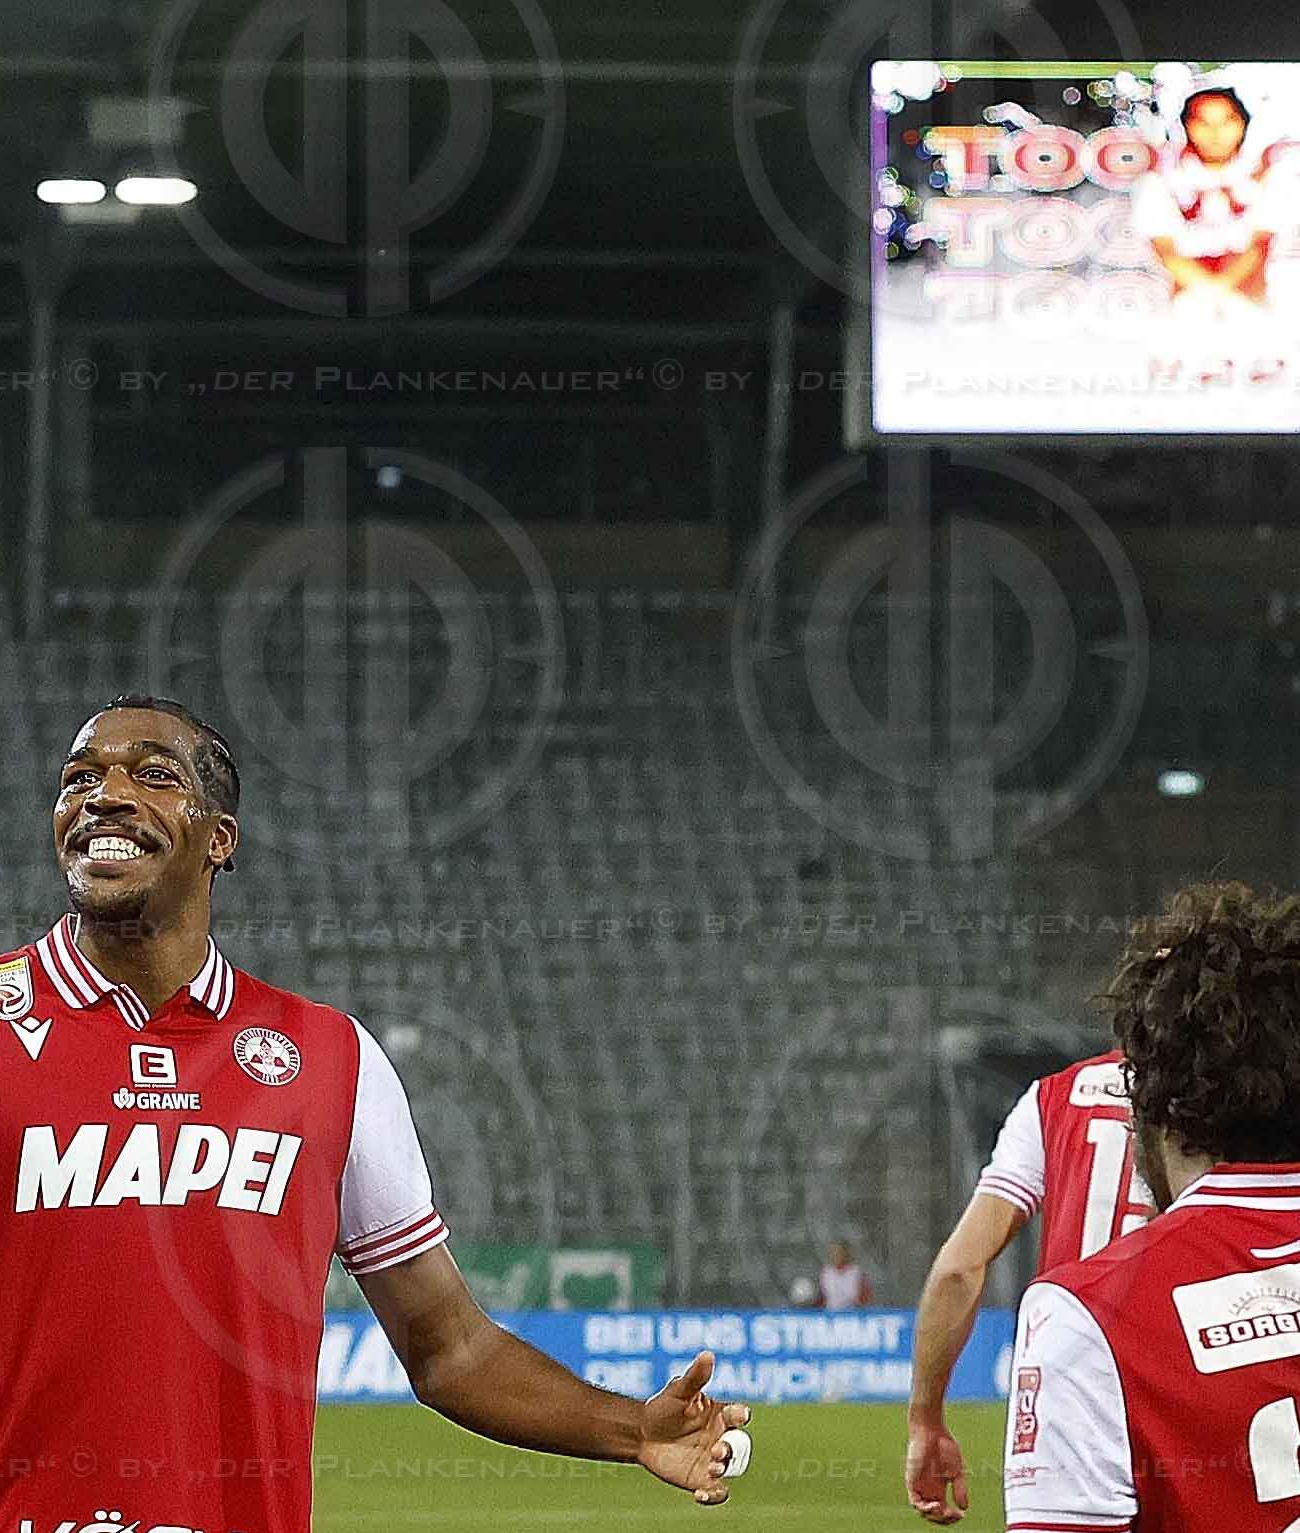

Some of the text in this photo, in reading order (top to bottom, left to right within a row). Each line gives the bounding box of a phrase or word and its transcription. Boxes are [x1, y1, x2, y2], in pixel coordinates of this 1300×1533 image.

[137, 1093, 200, 1110] GRAWE
[15, 1124, 302, 1216] MAPEI
[660, 1315, 746, 1354] UNS
